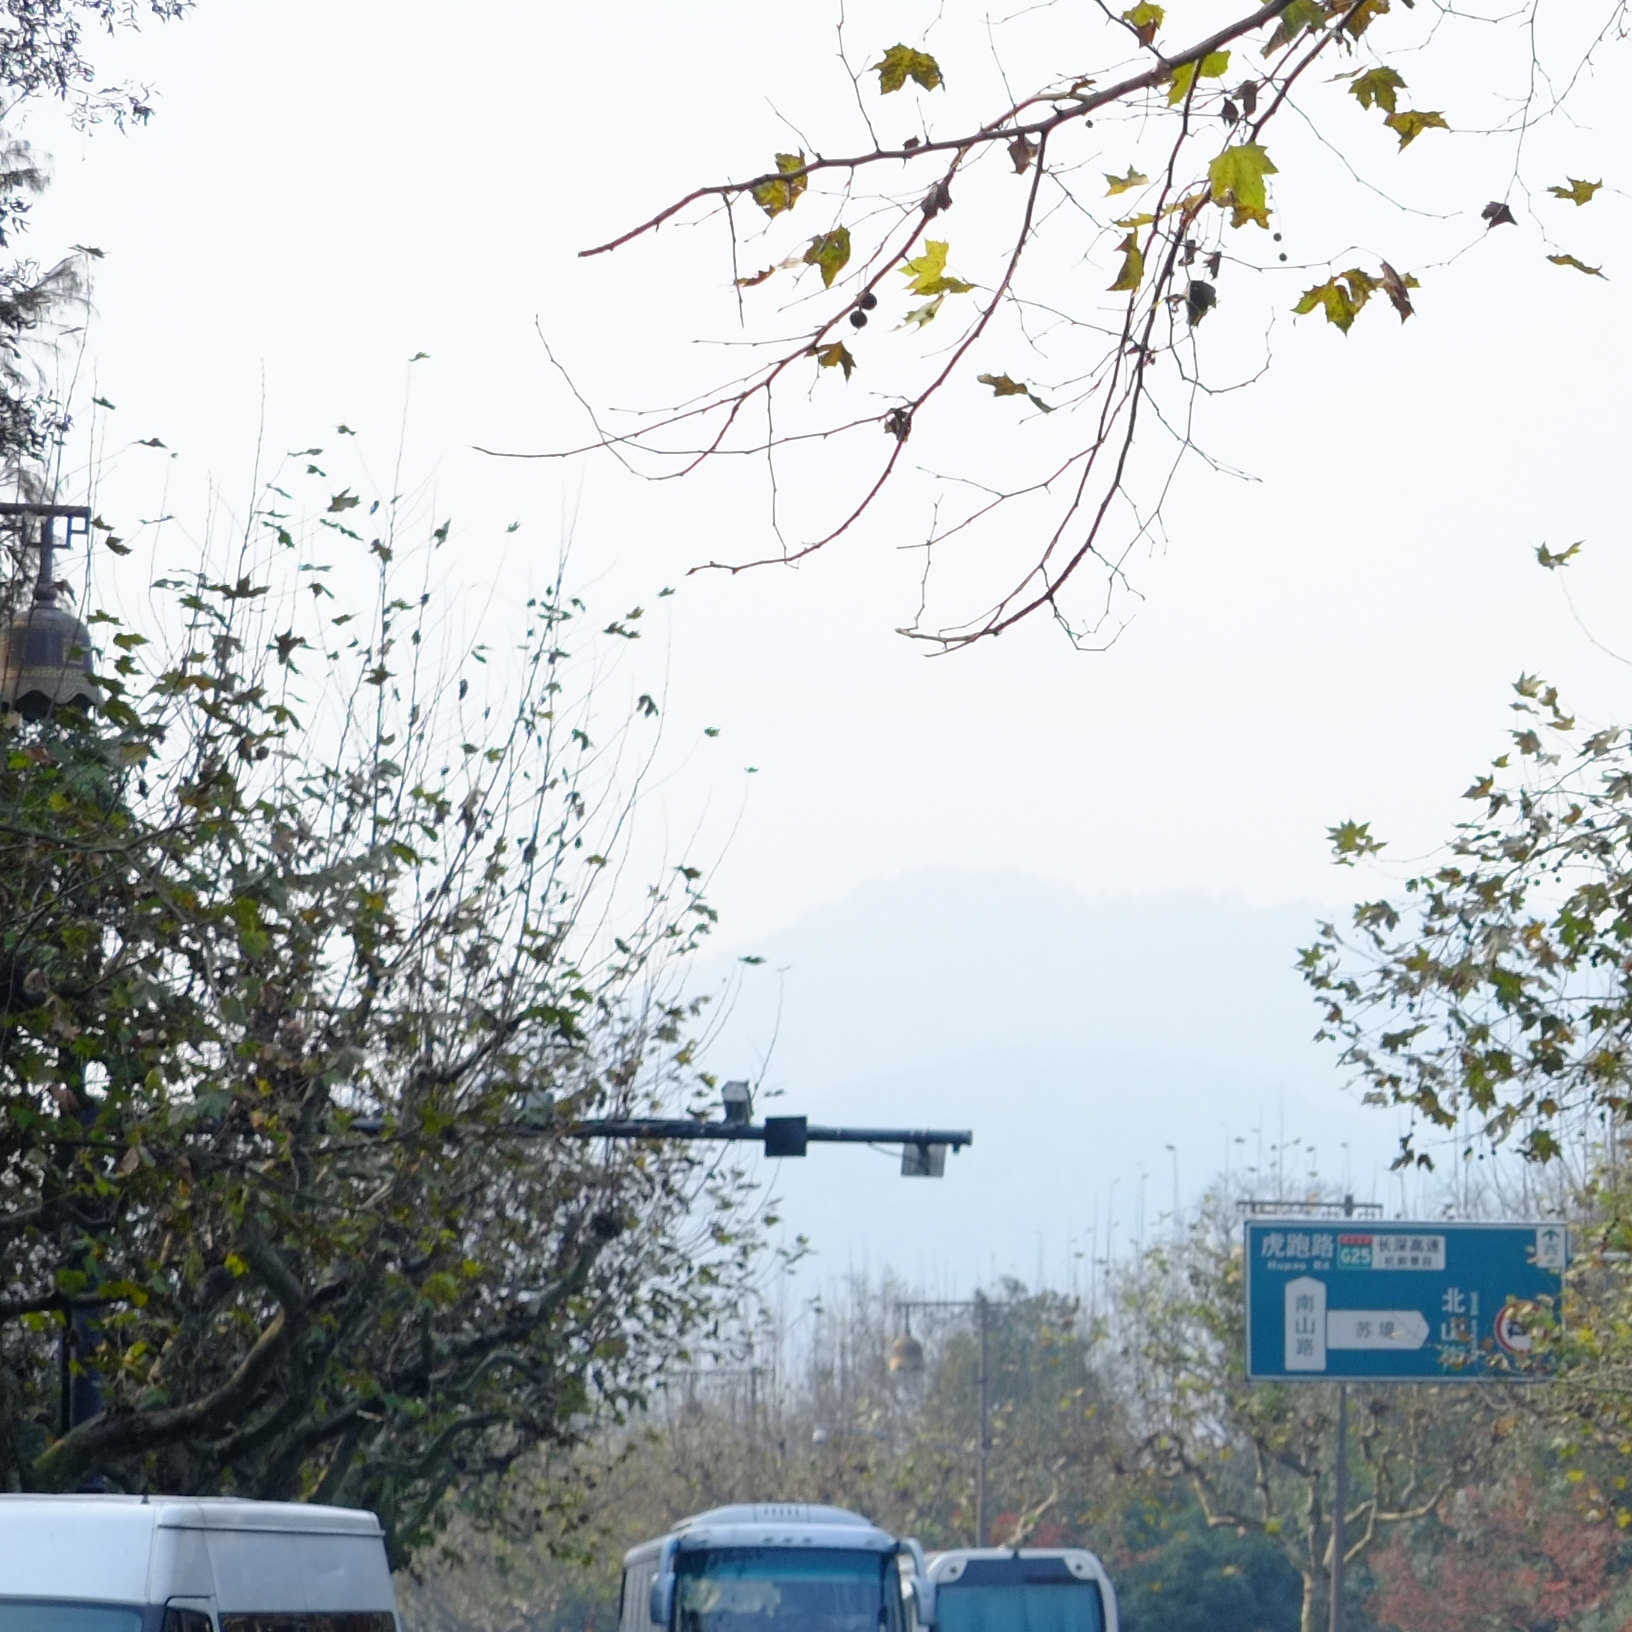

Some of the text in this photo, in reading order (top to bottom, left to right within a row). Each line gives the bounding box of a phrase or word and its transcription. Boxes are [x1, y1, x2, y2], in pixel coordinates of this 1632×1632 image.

[1262, 1232, 1334, 1259] 虎跑路
[1340, 1247, 1372, 1265] G25
[1379, 1238, 1440, 1253] 长深高速
[1295, 1293, 1316, 1357] 南山路
